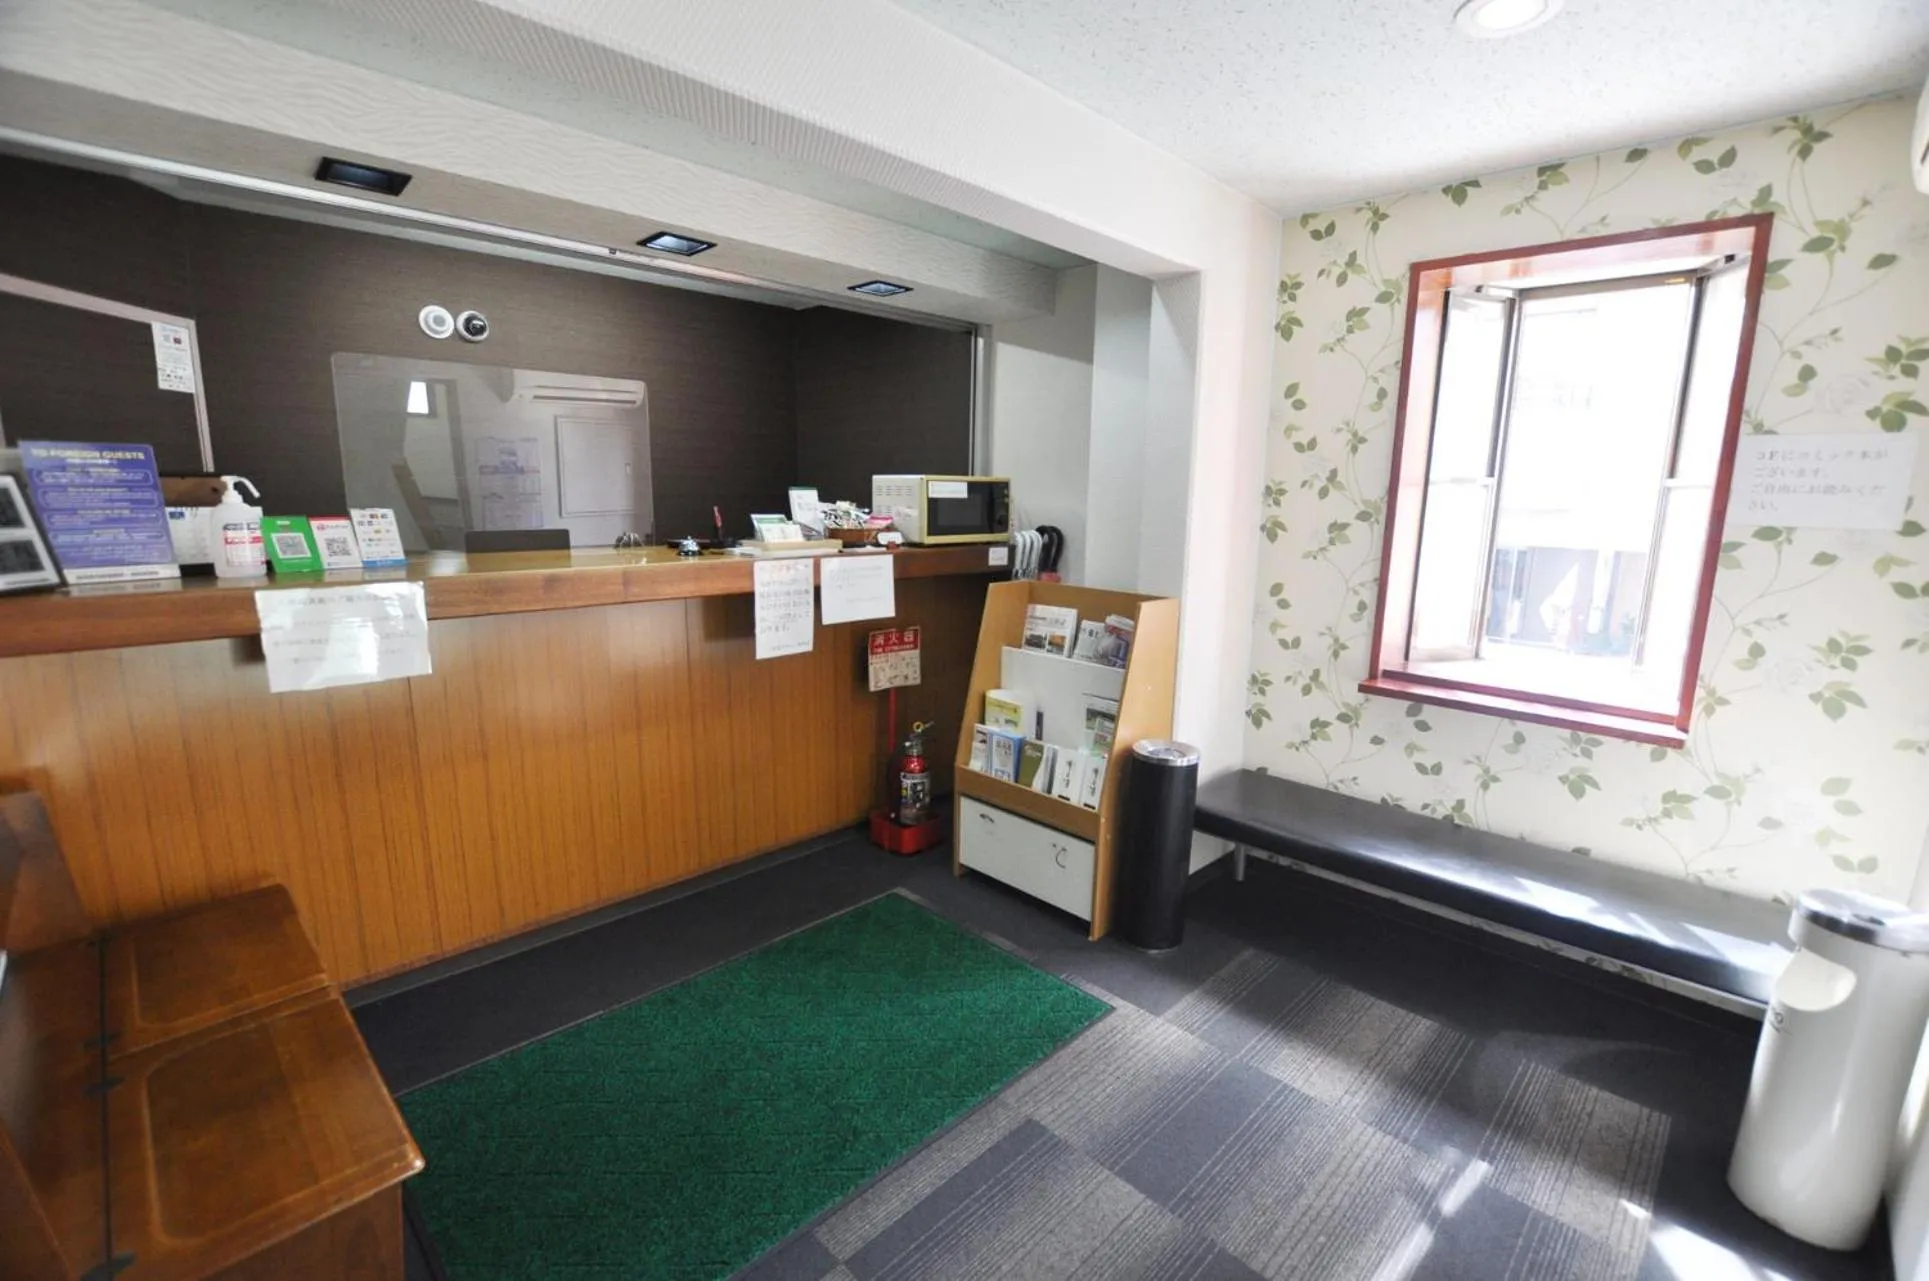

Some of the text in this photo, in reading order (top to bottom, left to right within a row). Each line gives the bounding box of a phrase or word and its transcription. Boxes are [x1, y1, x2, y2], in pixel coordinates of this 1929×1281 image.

[102, 450, 145, 460] GUESTS
[873, 631, 914, 646] 消火器
